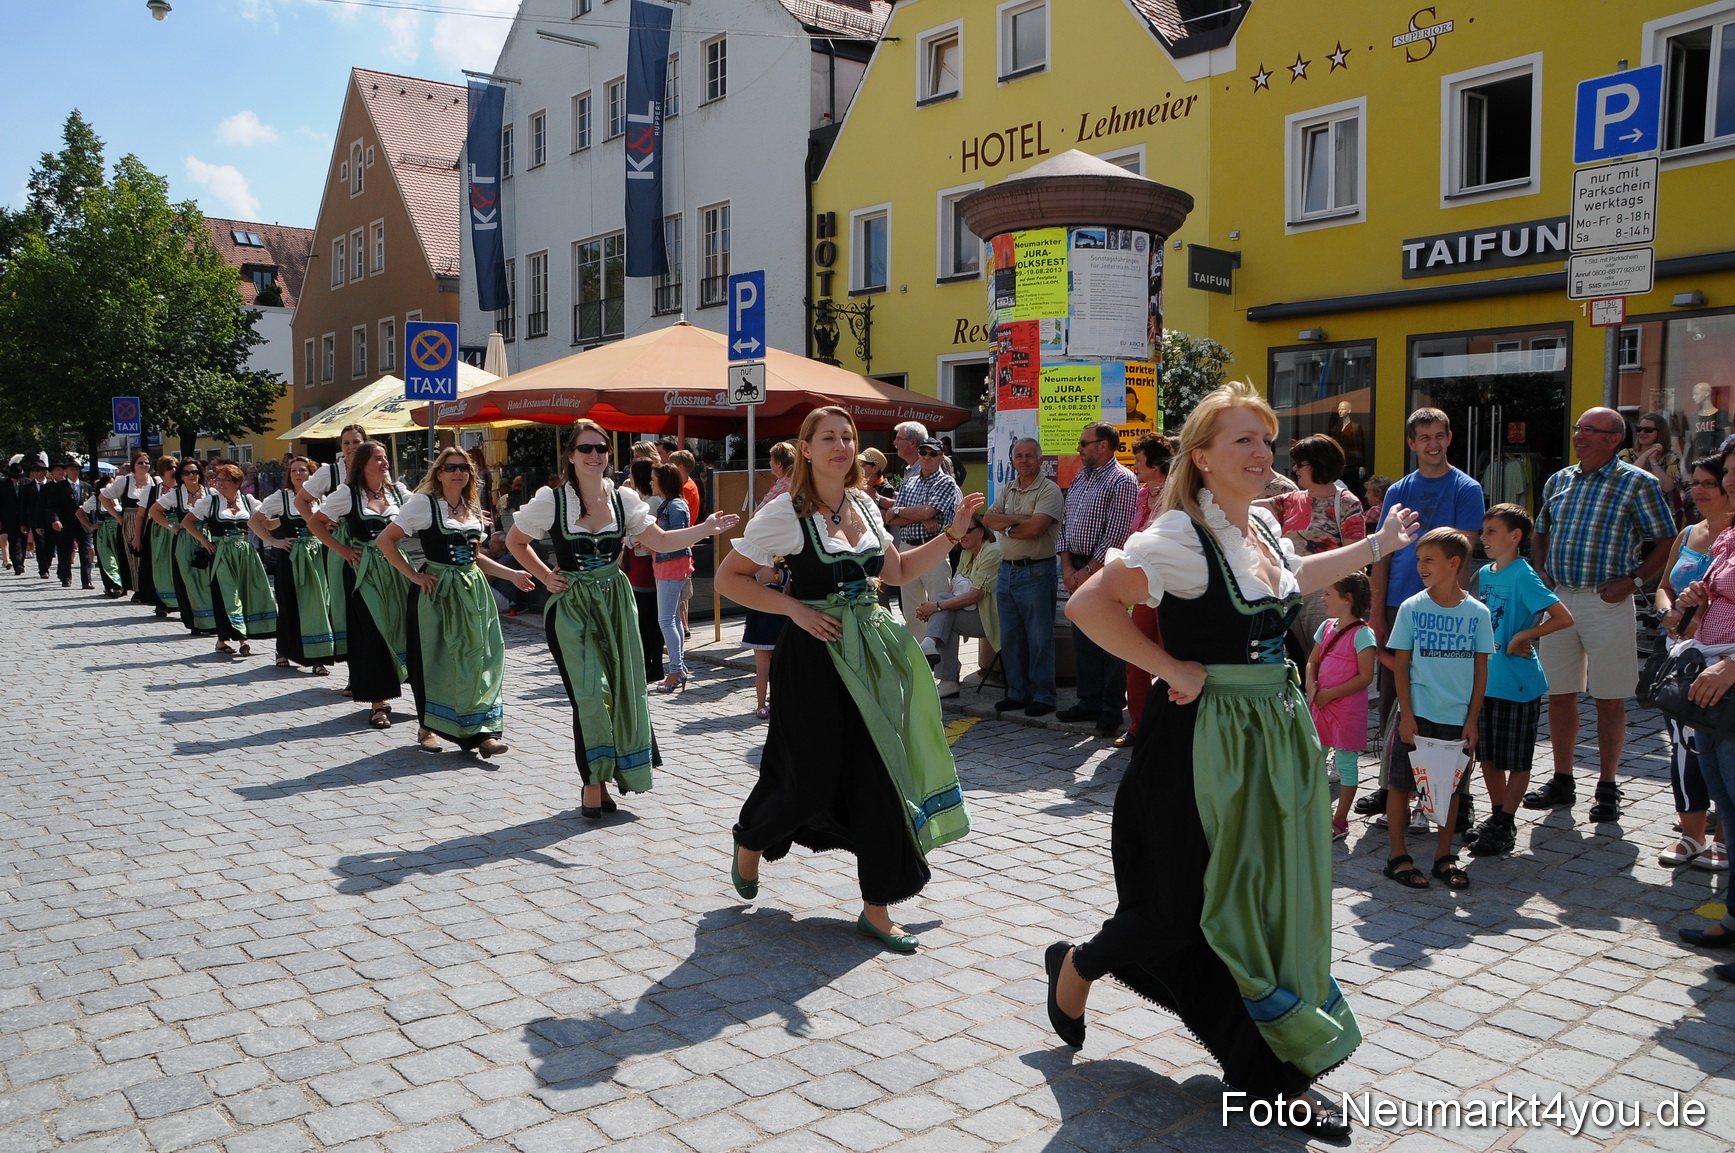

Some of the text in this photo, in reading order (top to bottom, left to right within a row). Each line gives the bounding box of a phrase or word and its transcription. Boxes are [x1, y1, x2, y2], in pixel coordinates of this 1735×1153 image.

[1397, 23, 1448, 45] SUPERIOR
[1594, 83, 1640, 150] P
[627, 101, 655, 180] K&L
[962, 91, 1198, 173] HOTEL Lehmeier
[1590, 167, 1639, 185] nur mit
[1579, 180, 1650, 199] Parkschein
[1584, 195, 1644, 212] werktags
[1015, 239, 1062, 249] Neumarkter
[1402, 222, 1567, 270] TAIFUN
[1576, 233, 1589, 243] Sa
[1024, 249, 1051, 258] JURA-
[1194, 272, 1230, 288] TAIFUN
[736, 281, 757, 332] P
[410, 377, 452, 394] TAXI
[507, 400, 522, 410] Hotel
[552, 394, 580, 408] Lehmeier
[1040, 395, 1099, 403] VOLKSFEST
[854, 405, 895, 416] Restaurant
[897, 406, 944, 423] Lehmeier
[116, 423, 138, 431] TAXI
[1695, 421, 1715, 432] SALE
[1412, 611, 1479, 634] NOBODY IS
[1414, 628, 1474, 650] PERFECT
